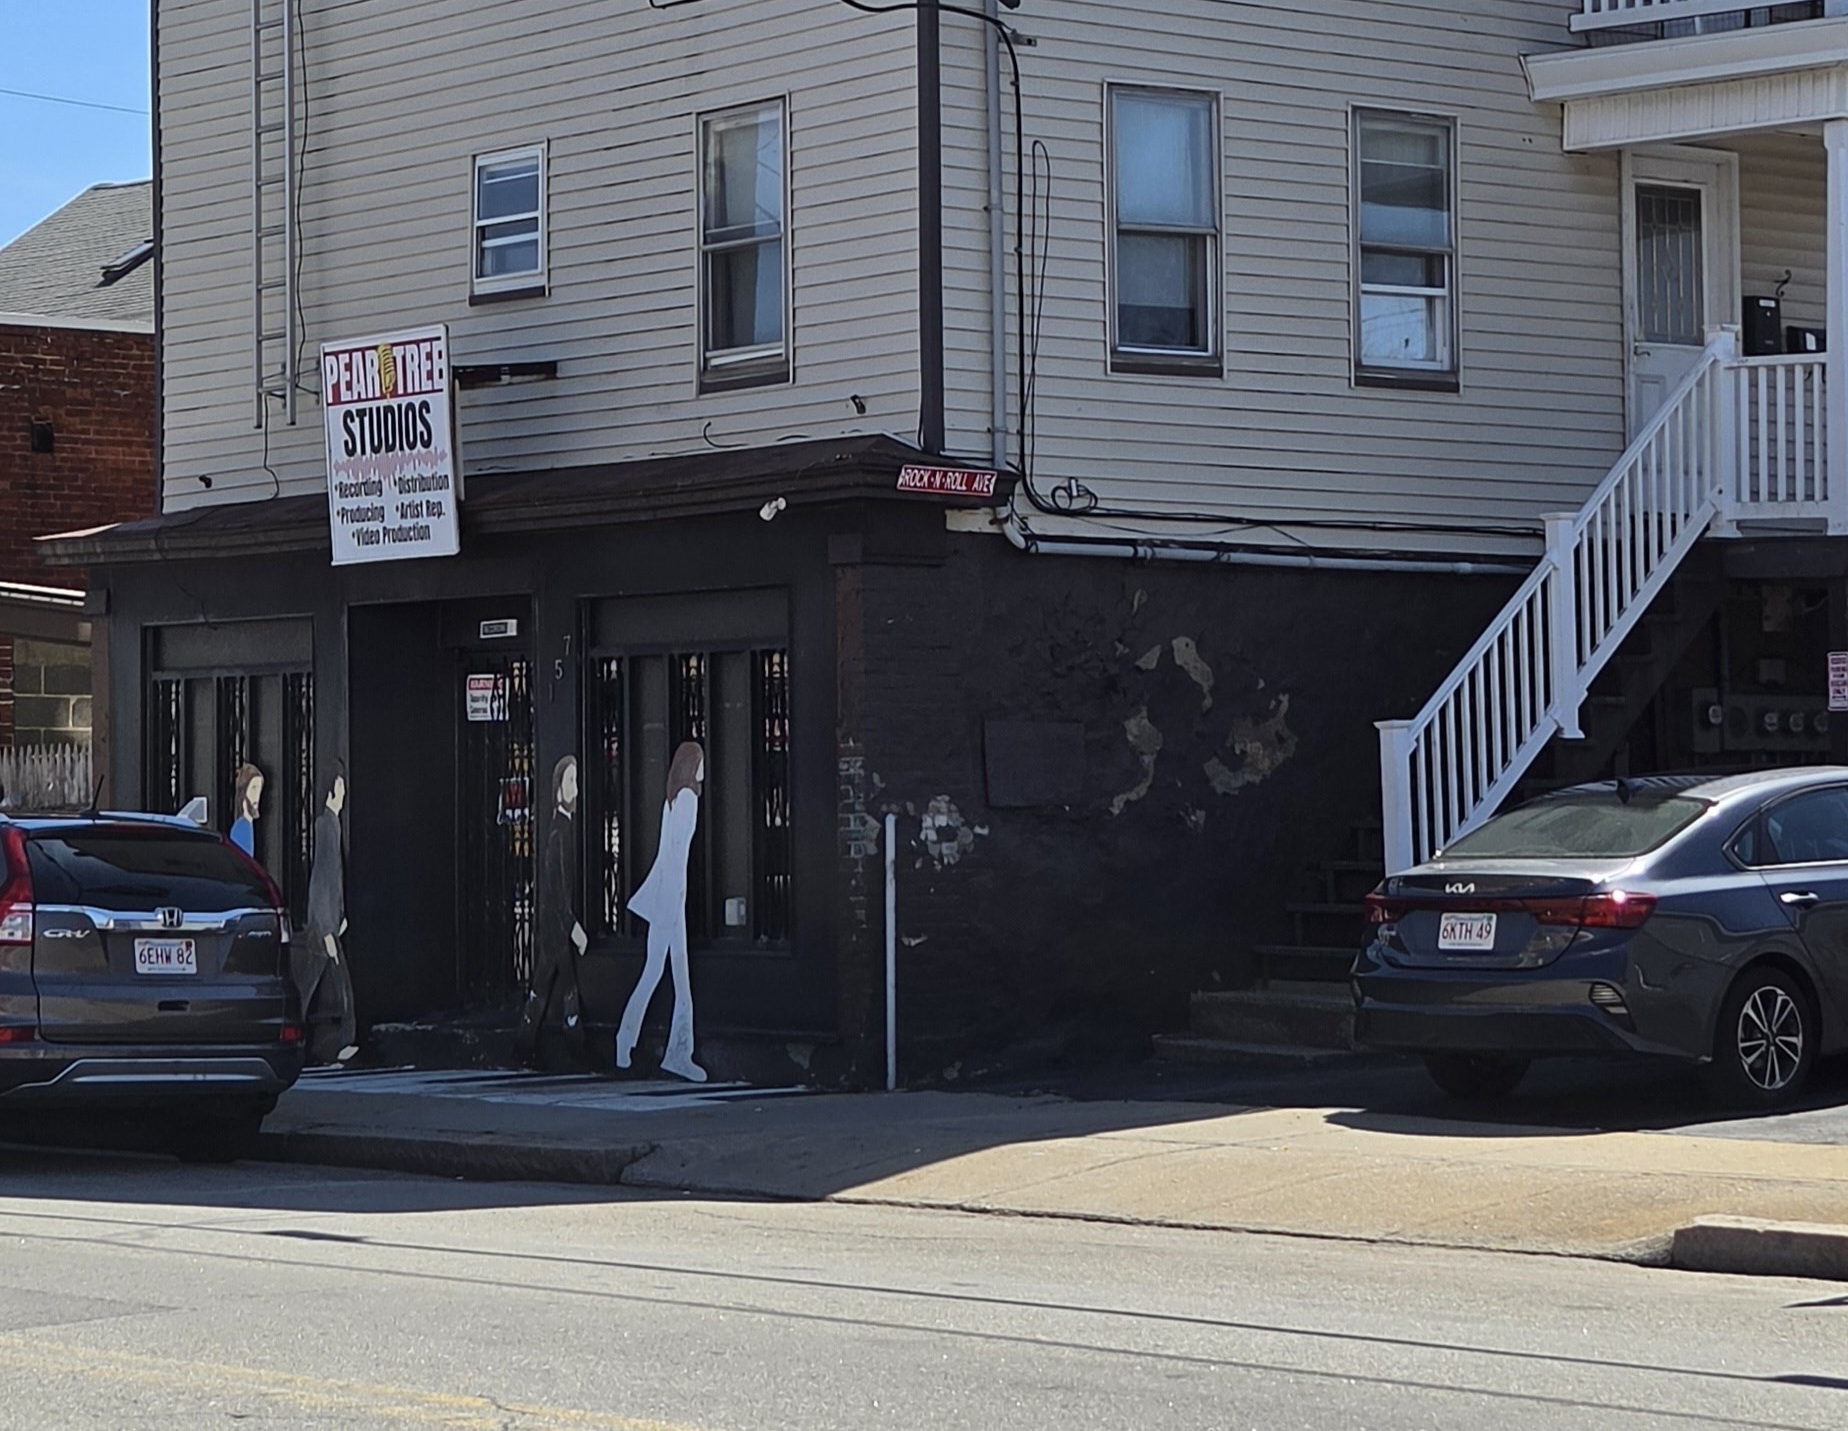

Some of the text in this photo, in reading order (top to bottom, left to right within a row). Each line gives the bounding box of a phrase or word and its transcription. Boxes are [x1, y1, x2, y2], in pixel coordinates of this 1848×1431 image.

[325, 340, 444, 404] PEAR TREE
[342, 400, 432, 458] STUDIOS
[971, 473, 992, 492] AVE
[382, 521, 431, 546] Production
[1442, 922, 1492, 941] 6KTH 49
[139, 947, 193, 965] 6EHW 82
